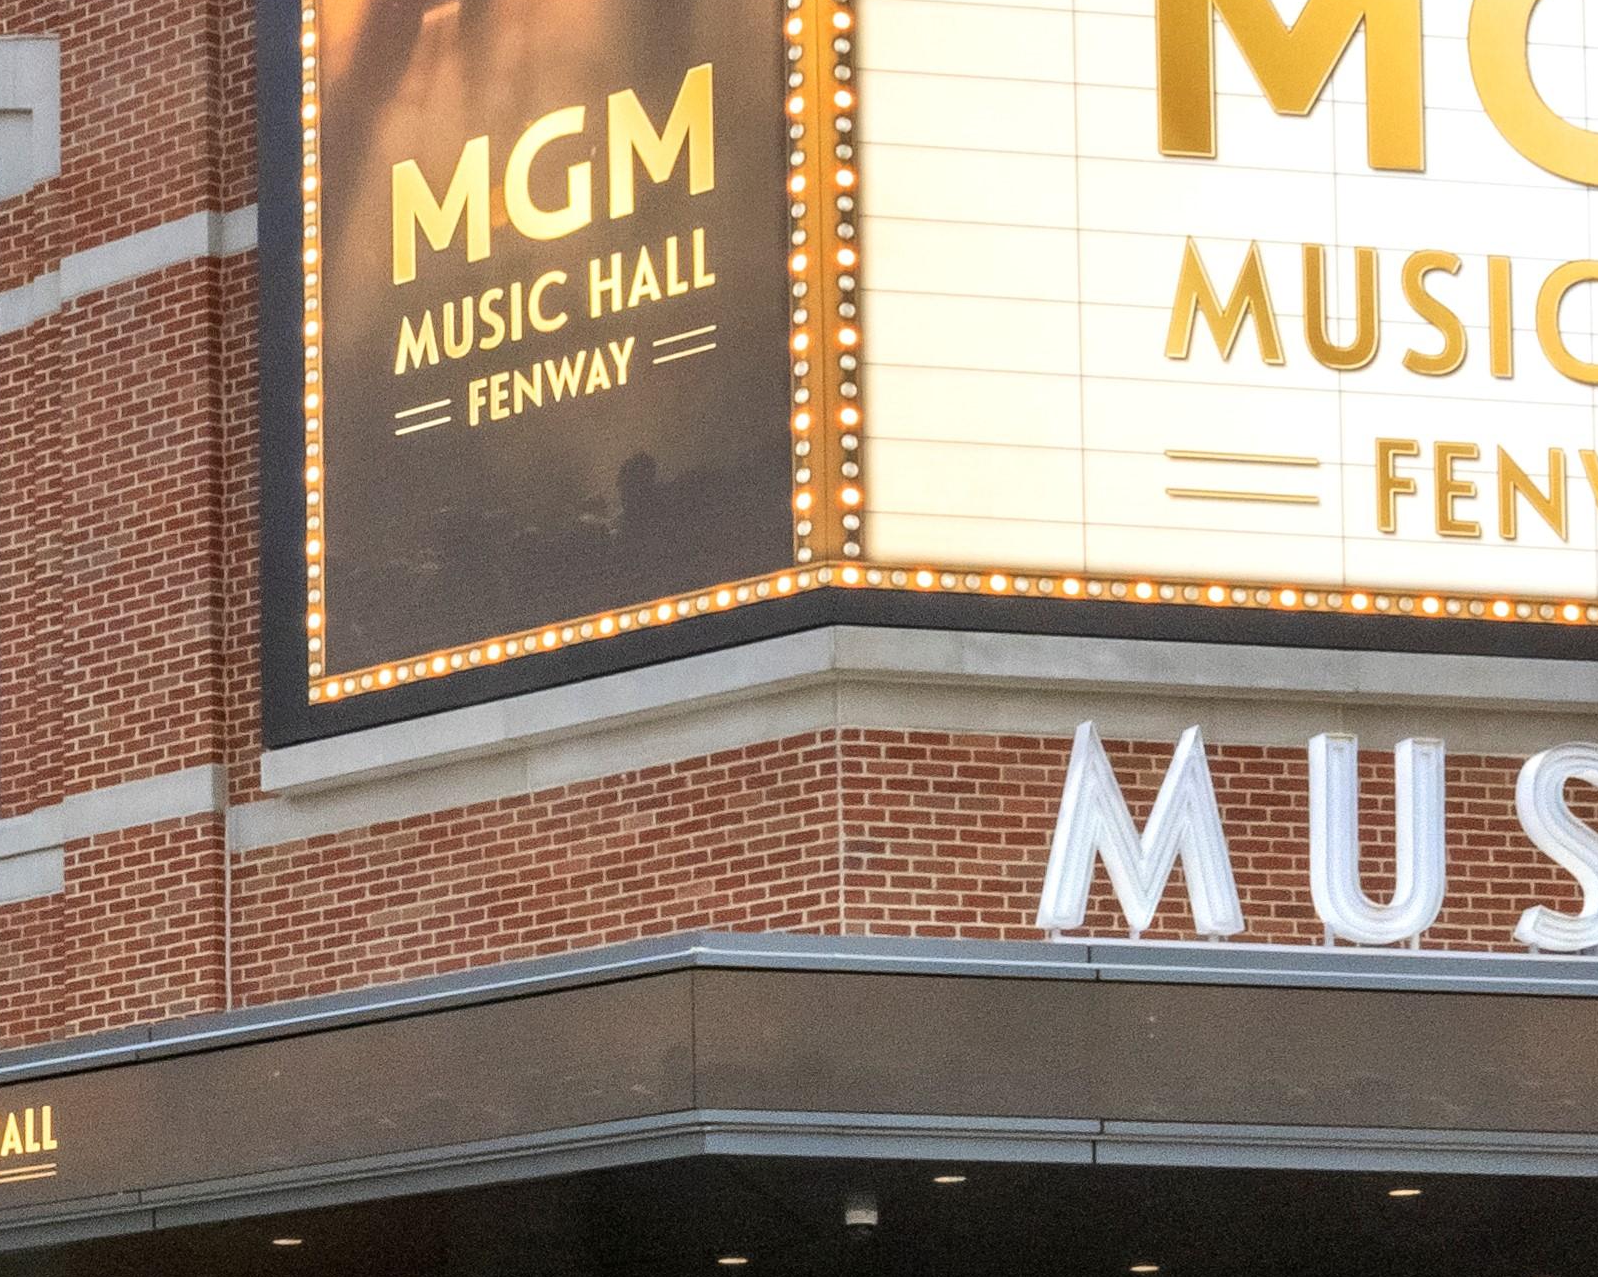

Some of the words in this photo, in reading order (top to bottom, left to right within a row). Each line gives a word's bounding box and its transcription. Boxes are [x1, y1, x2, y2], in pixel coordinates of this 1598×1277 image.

[391, 62, 717, 287] MGM
[394, 269, 569, 376] MUSIC
[588, 227, 718, 322] HALL
[467, 336, 636, 427] FENWAY
